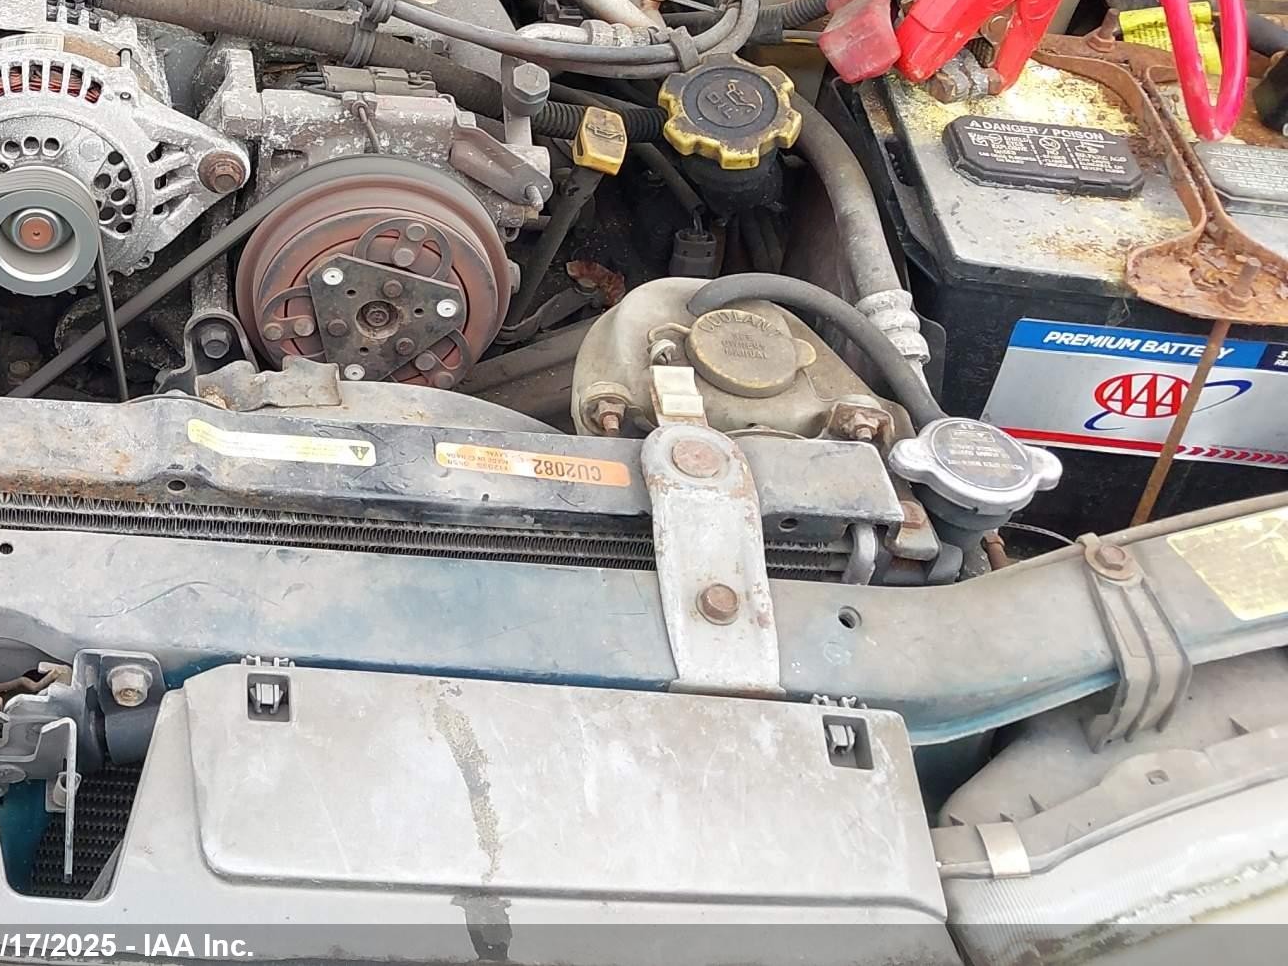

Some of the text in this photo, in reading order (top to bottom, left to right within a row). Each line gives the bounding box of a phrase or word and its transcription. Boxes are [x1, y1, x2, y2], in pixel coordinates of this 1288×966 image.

[705, 91, 733, 119] OIL
[982, 121, 1040, 134] DANGER
[1051, 128, 1105, 141] POISON
[697, 312, 782, 337] COOLANT
[1043, 331, 1236, 360] PREMIUM BATTEY
[1101, 374, 1184, 419] AAA
[531, 458, 602, 482] CU2082
